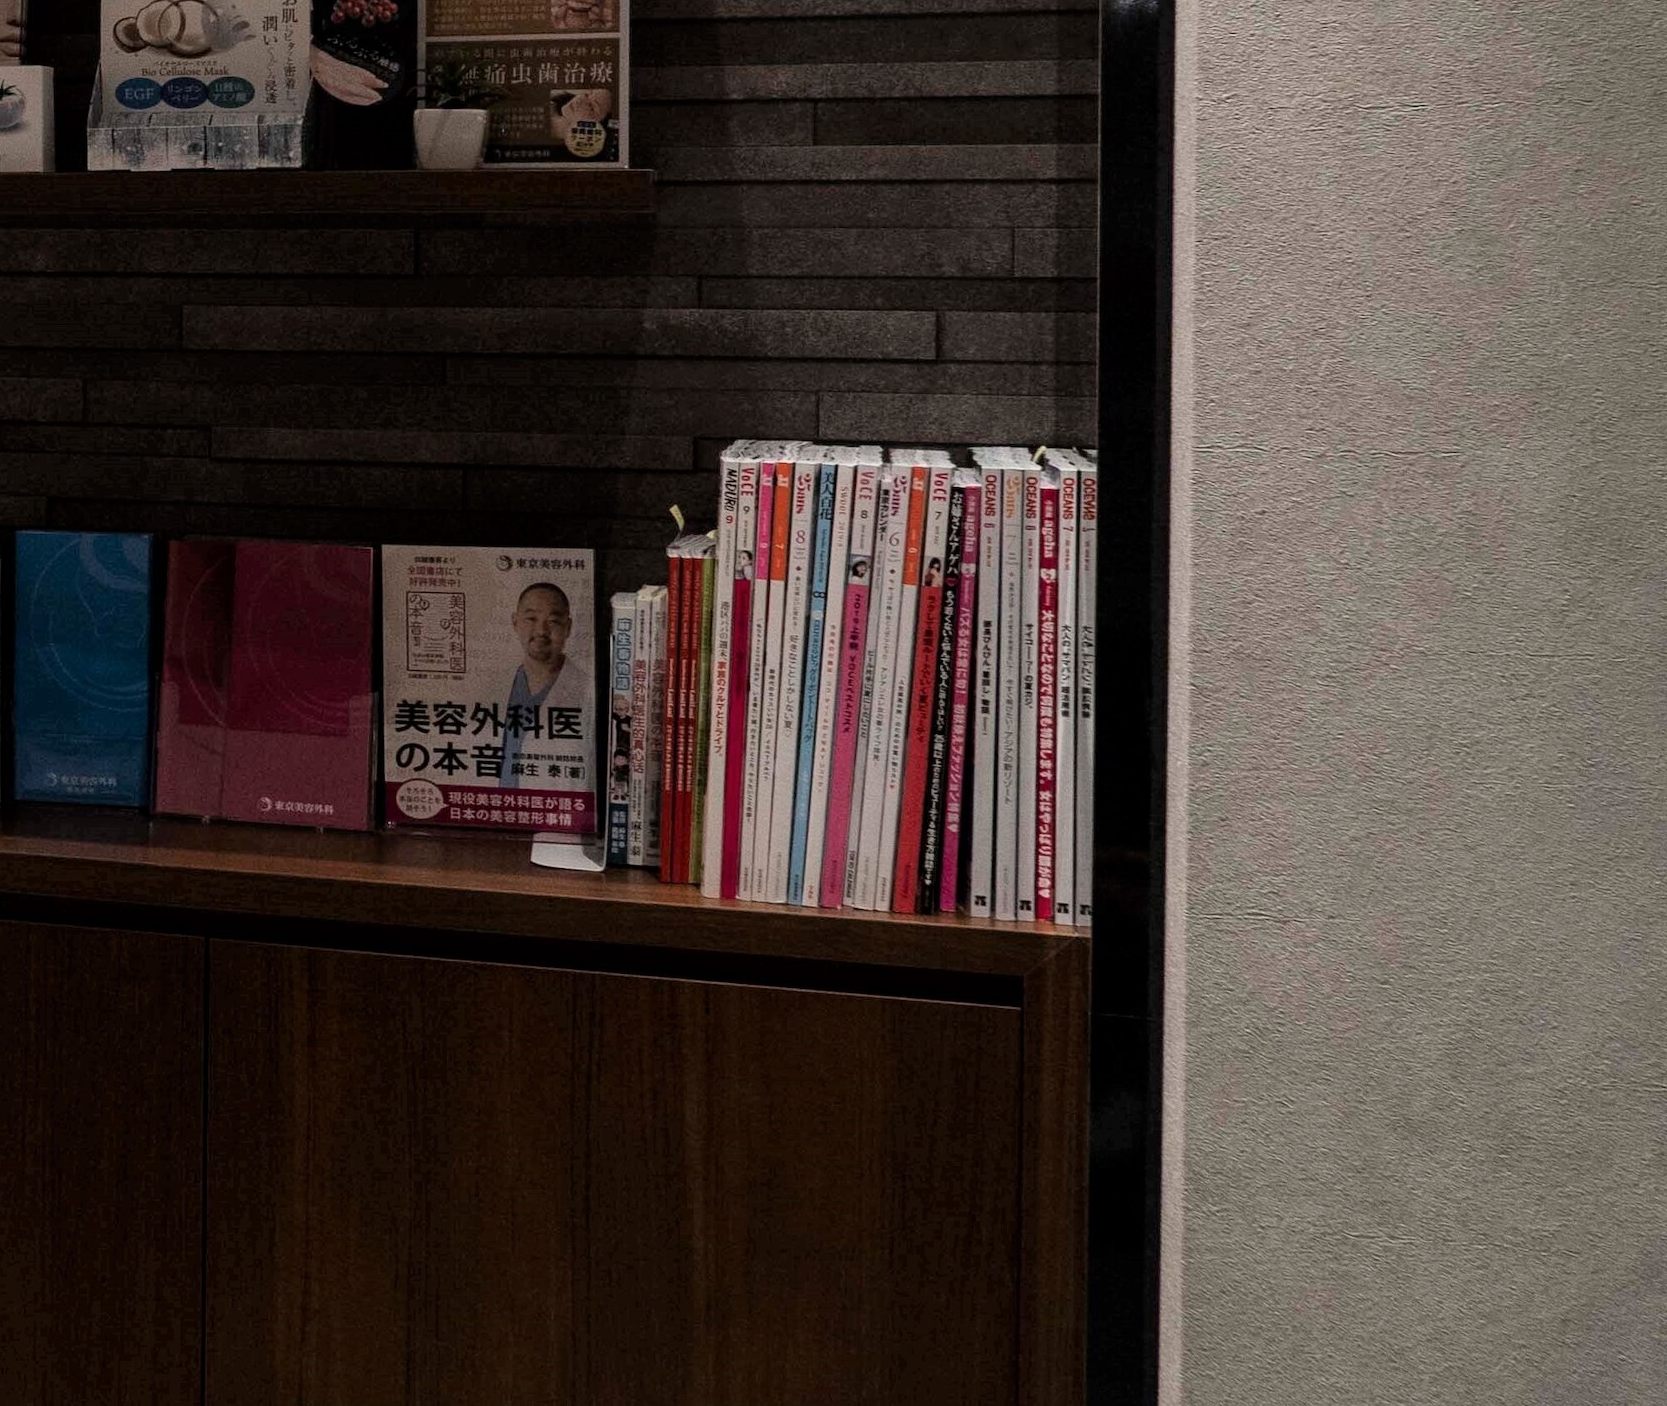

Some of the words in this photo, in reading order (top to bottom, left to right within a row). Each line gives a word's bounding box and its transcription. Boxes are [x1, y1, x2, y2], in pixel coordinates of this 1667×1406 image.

[141, 66, 158, 75] Bio
[161, 65, 202, 75] Cellulose
[204, 64, 230, 75] Mask
[125, 87, 156, 101] EGF
[742, 505, 750, 514] 9
[820, 472, 835, 521] 美人百花
[984, 474, 998, 517] OCEANS
[1025, 476, 1039, 520] OCEANS
[1062, 477, 1075, 521] OCEANS
[948, 492, 964, 575] お姉さんアゲハ
[408, 565, 463, 576] 全国書店にて
[516, 557, 586, 570] 東京美容外科
[409, 594, 424, 636] の本音
[449, 595, 465, 672] 美容外科医
[395, 700, 584, 740] 美容外科医
[396, 741, 505, 779] の本音
[511, 762, 540, 778] 麻生
[274, 801, 334, 815] 東京美容外科
[447, 791, 586, 812] 現役美容外科医が語る
[449, 806, 573, 827] 日本の美容整形事情
